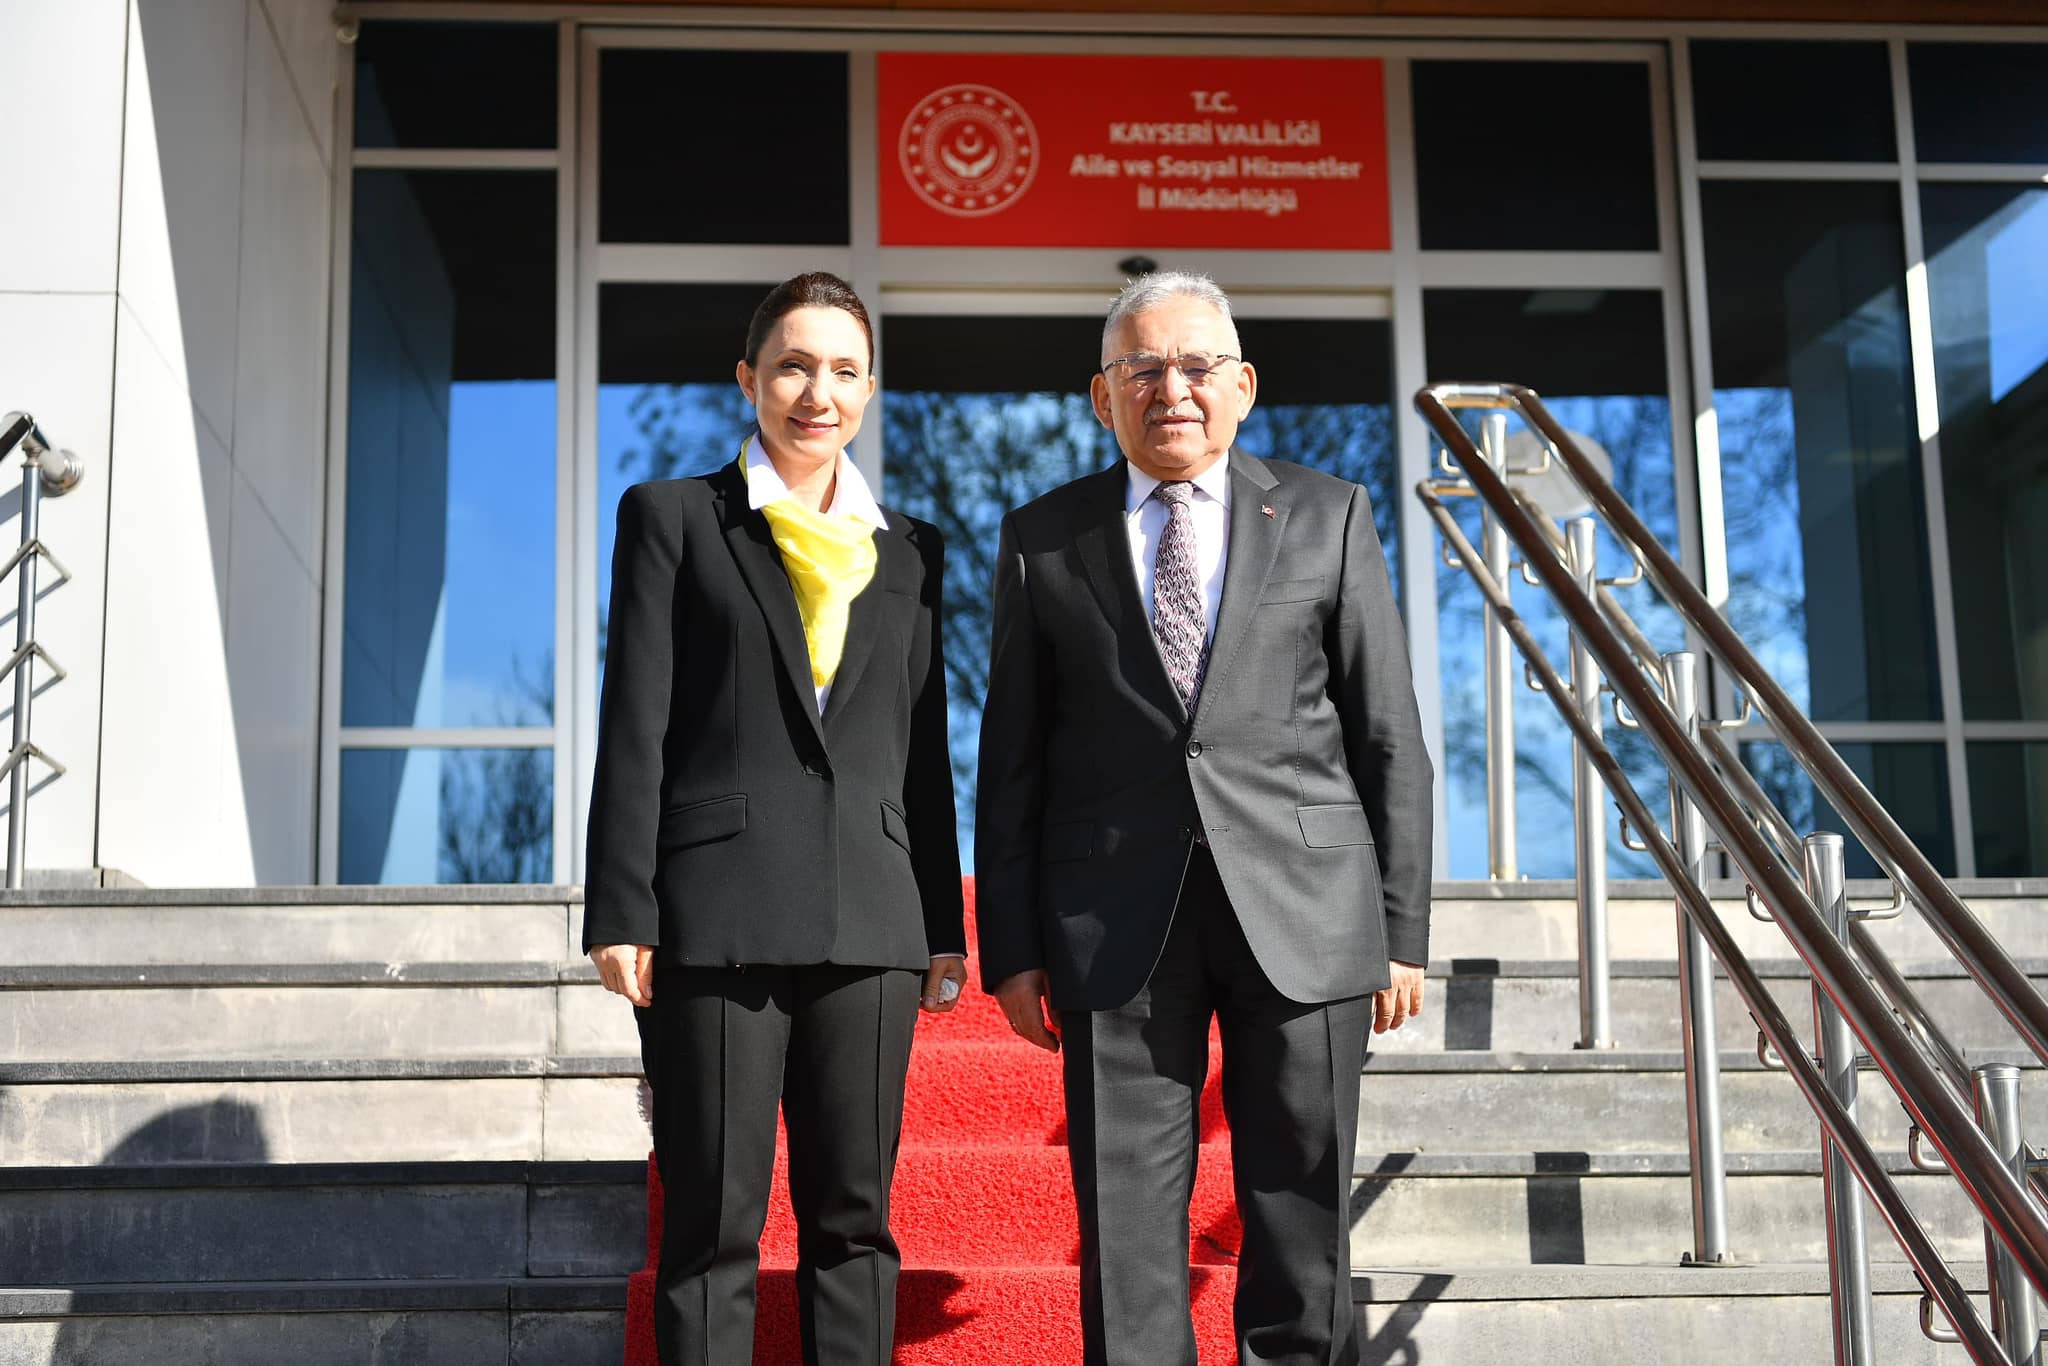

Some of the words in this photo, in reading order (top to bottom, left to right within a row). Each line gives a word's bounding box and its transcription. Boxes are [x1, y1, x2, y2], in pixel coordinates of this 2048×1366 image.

[1191, 91, 1237, 112] T.C.
[1110, 120, 1213, 145] KAYSERİ
[1216, 120, 1320, 146] VALİLİĞİ
[1070, 155, 1119, 177] Aile
[1124, 160, 1154, 177] ve
[1157, 155, 1237, 182] Sosyal
[1241, 157, 1362, 178] Hizmetler
[1158, 187, 1297, 216] Müdürlüğü
